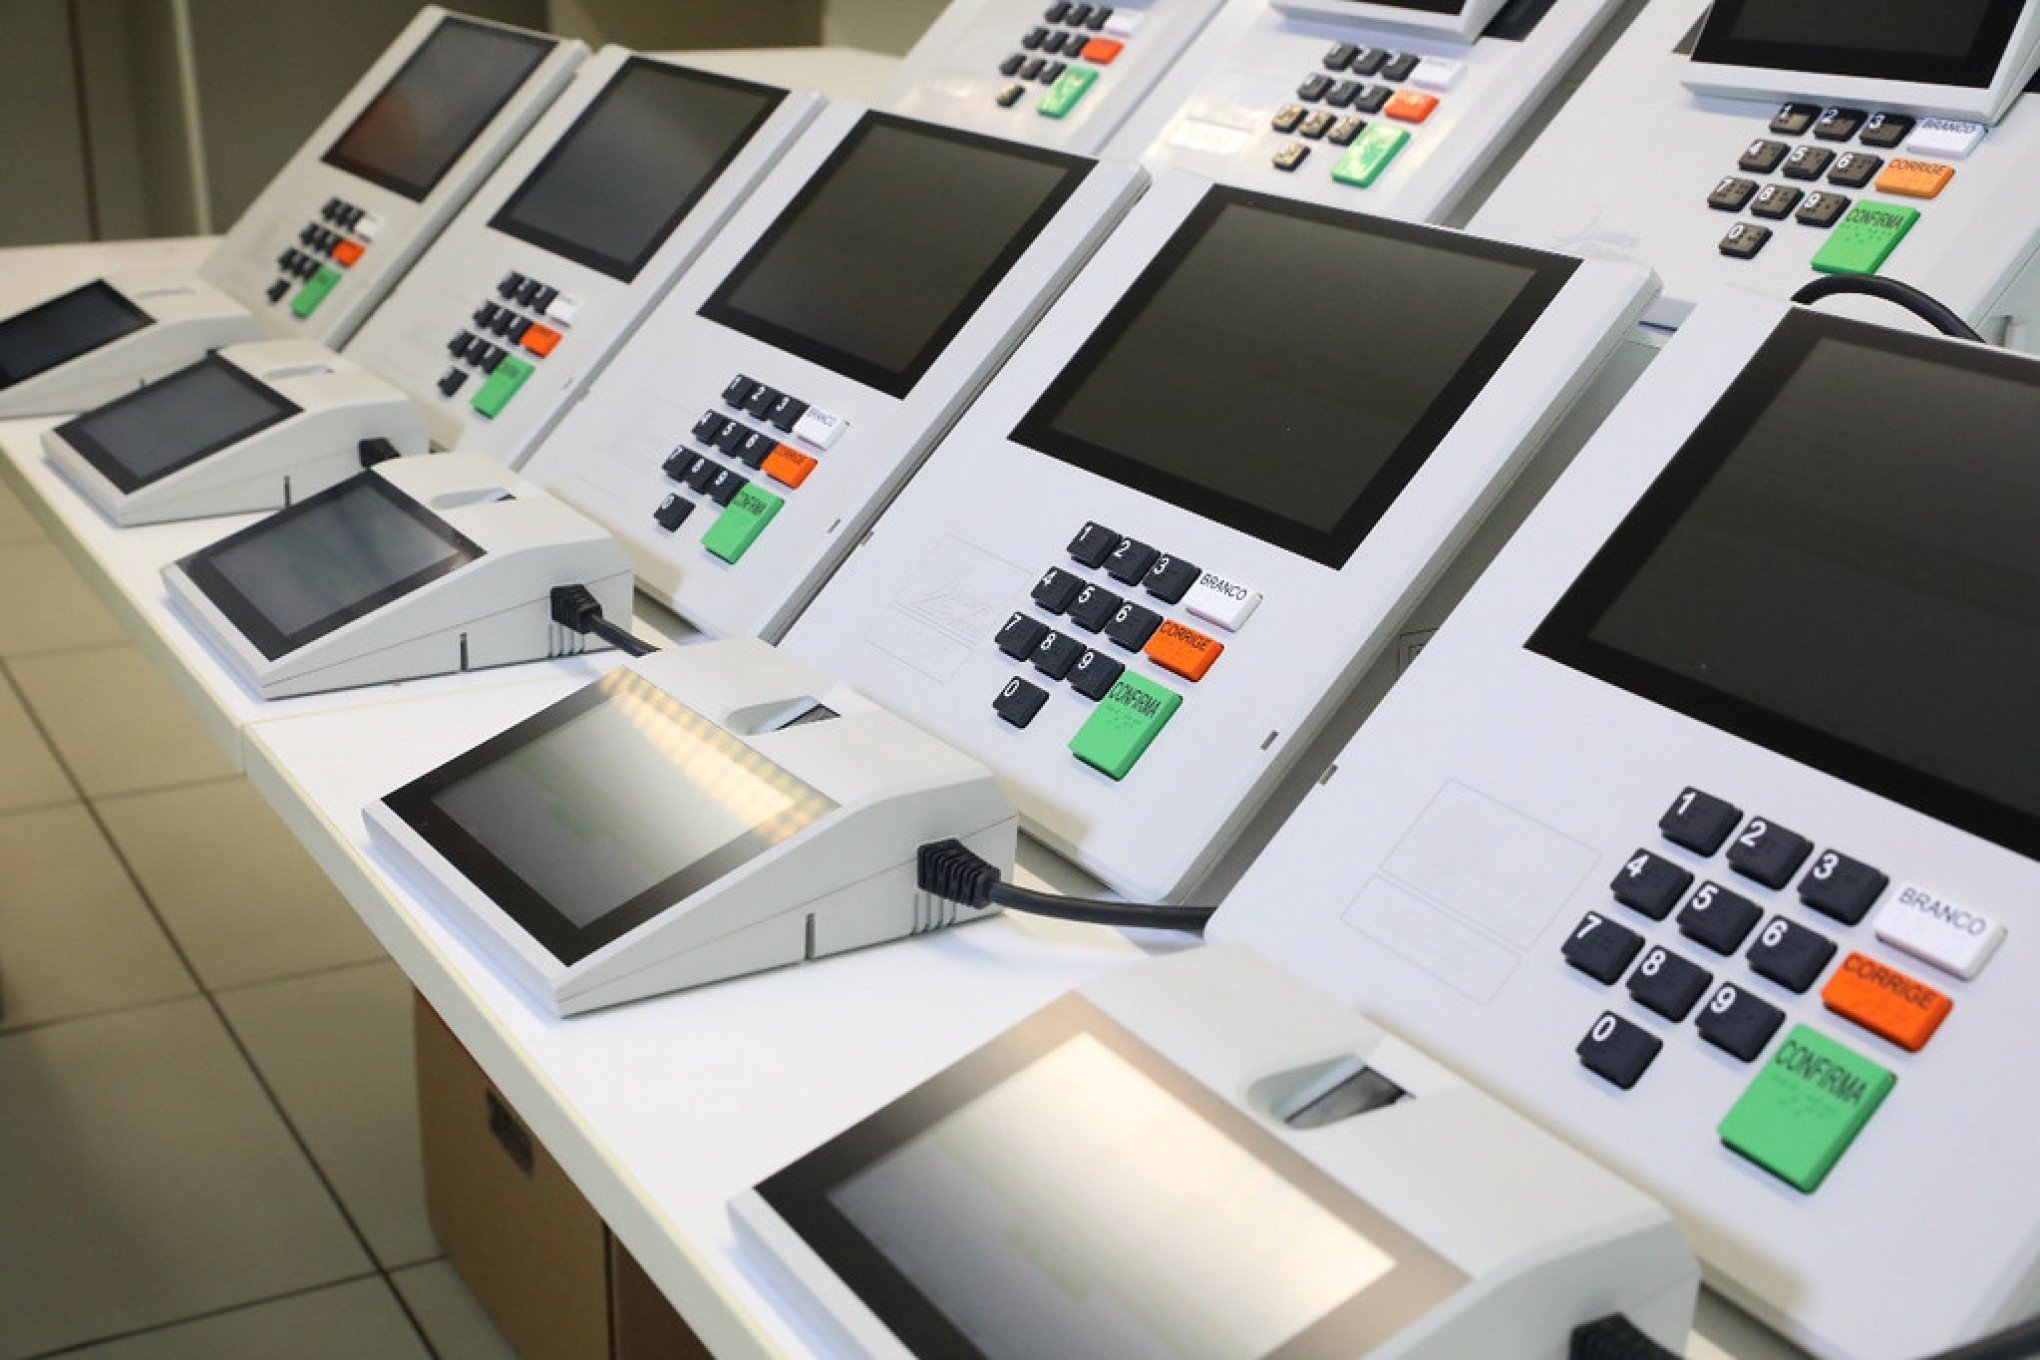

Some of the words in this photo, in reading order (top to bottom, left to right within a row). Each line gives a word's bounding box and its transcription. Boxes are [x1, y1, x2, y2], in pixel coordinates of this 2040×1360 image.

[1821, 108, 1838, 124] 2
[1869, 113, 1885, 129] 3
[1838, 152, 1853, 168] 6
[1889, 158, 1946, 175] CORRIGE
[1079, 525, 1093, 541] 1
[1113, 540, 1131, 557] 2
[1154, 557, 1170, 575] 3
[1199, 573, 1247, 601] BRANCO
[1004, 614, 1021, 630] 7
[1041, 632, 1056, 650] 8
[1078, 652, 1094, 670] 9
[1043, 570, 1058, 587] 4
[1079, 586, 1095, 603] 5
[1116, 605, 1133, 622] 6
[1160, 620, 1209, 652] CORRIGE
[1004, 680, 1020, 697] 0
[1108, 681, 1162, 719] CONFIRMA
[1676, 792, 1697, 814] 1
[1741, 821, 1767, 847] 2
[1814, 855, 1838, 880] 3
[1898, 886, 1988, 937] BRANCO
[1577, 917, 1601, 939] 7
[1642, 950, 1667, 975] 8
[1711, 987, 1736, 1012] 9
[1626, 856, 1649, 878] 4
[1693, 885, 1718, 910] 5
[1762, 921, 1789, 946] 6
[1843, 955, 1933, 1011] CORRIGE
[1592, 1016, 1616, 1041] 0
[1774, 1038, 1869, 1108] CONFIRMA
